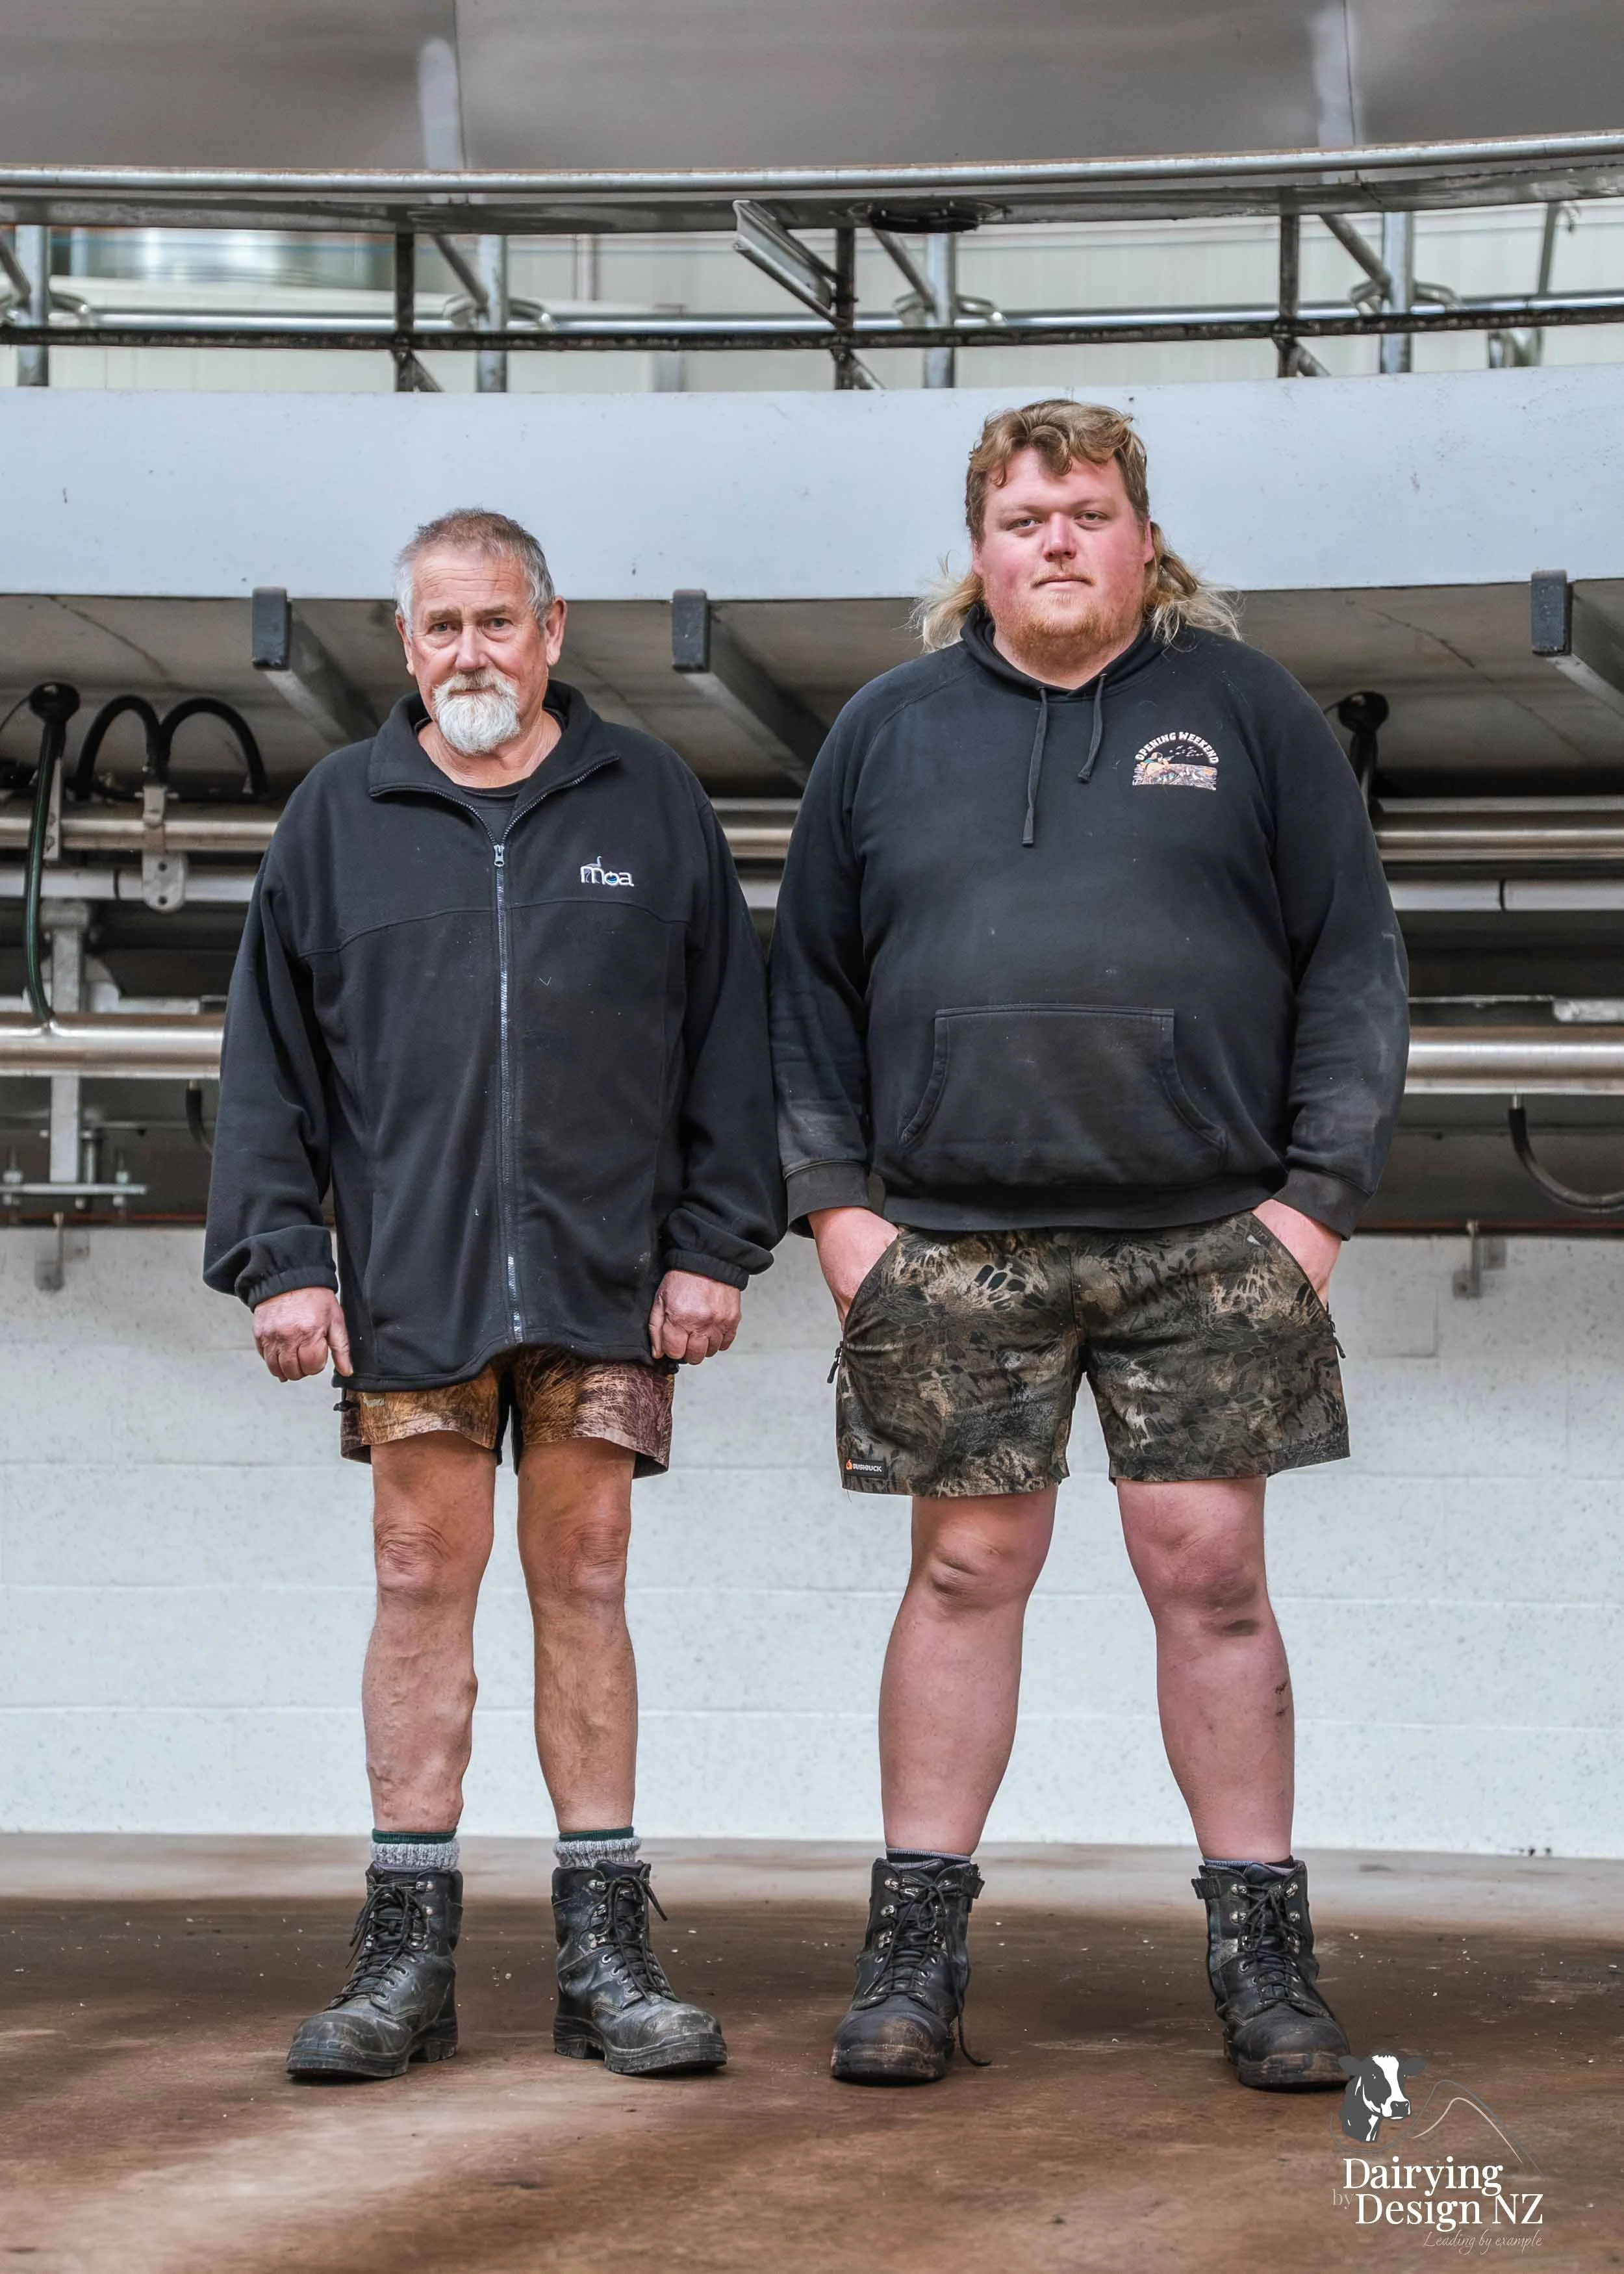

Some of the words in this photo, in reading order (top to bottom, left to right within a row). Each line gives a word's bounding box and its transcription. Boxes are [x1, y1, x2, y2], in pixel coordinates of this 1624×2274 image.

[1135, 732, 1176, 761] OPENING
[1178, 732, 1219, 764] WEEKEND
[580, 865, 635, 887] moa
